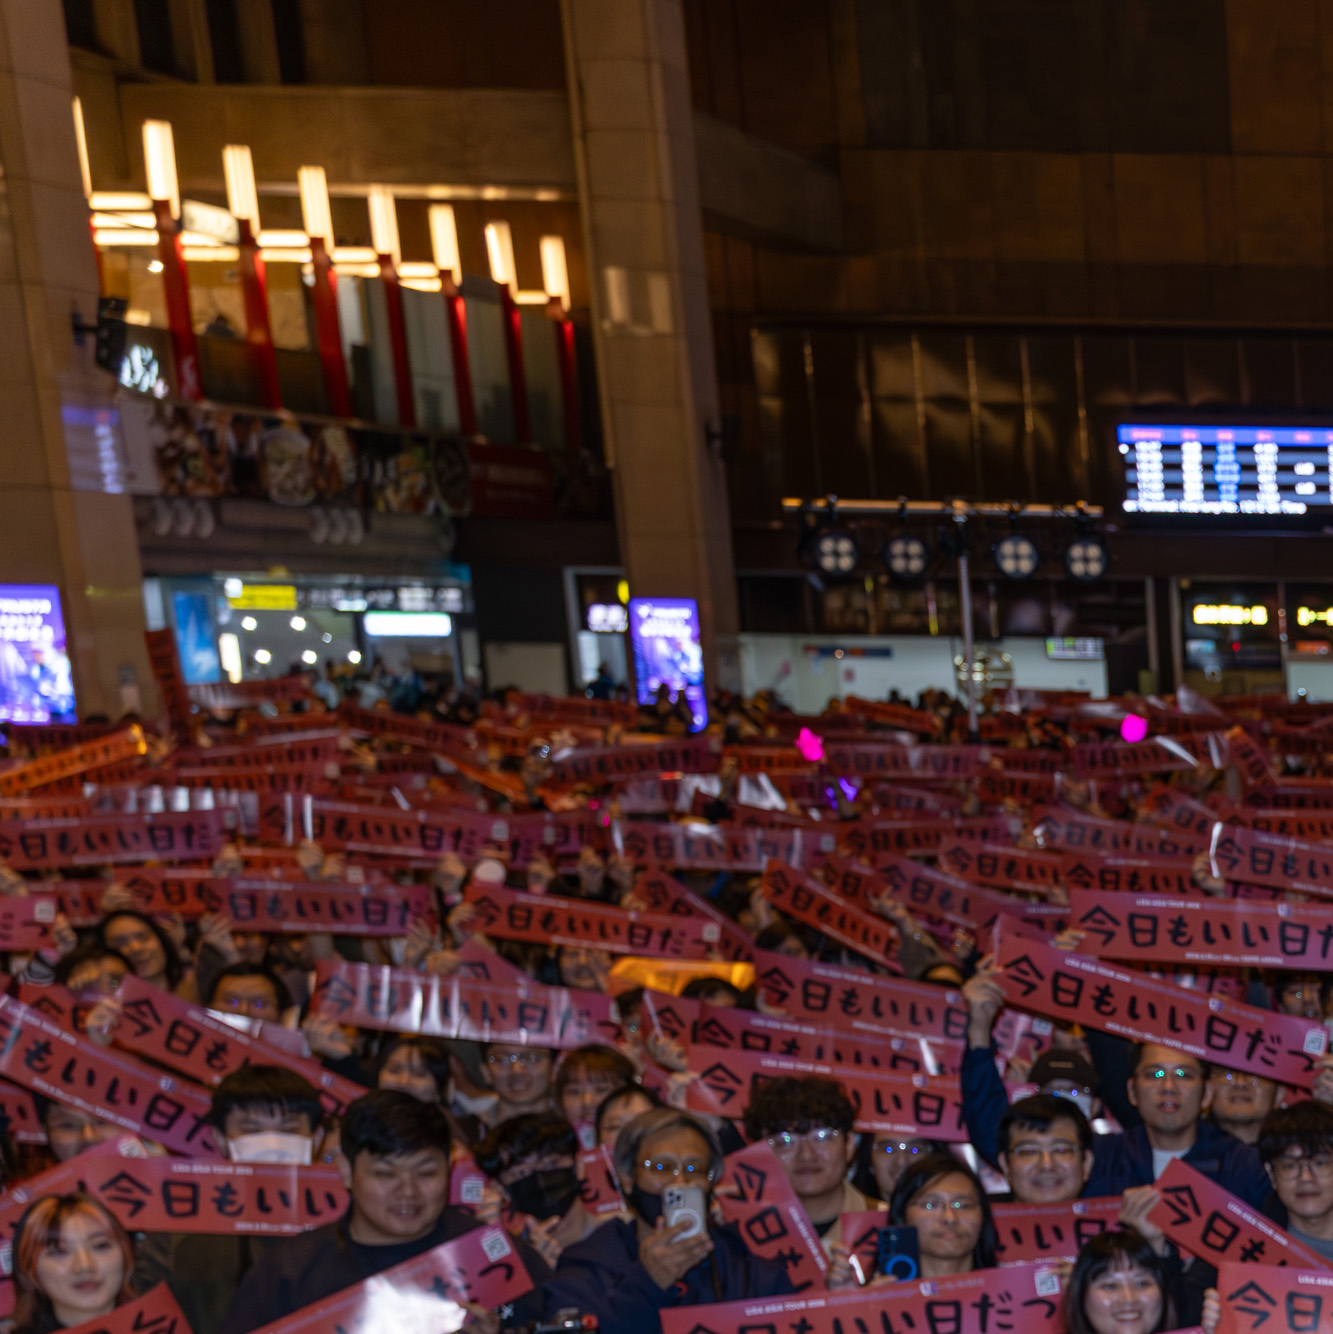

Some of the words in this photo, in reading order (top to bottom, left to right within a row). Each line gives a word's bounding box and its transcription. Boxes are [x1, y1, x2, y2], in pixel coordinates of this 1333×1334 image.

[760, 966, 970, 1041] 今日もいい日
[1004, 954, 1317, 1071] 今日もいい日だっ
